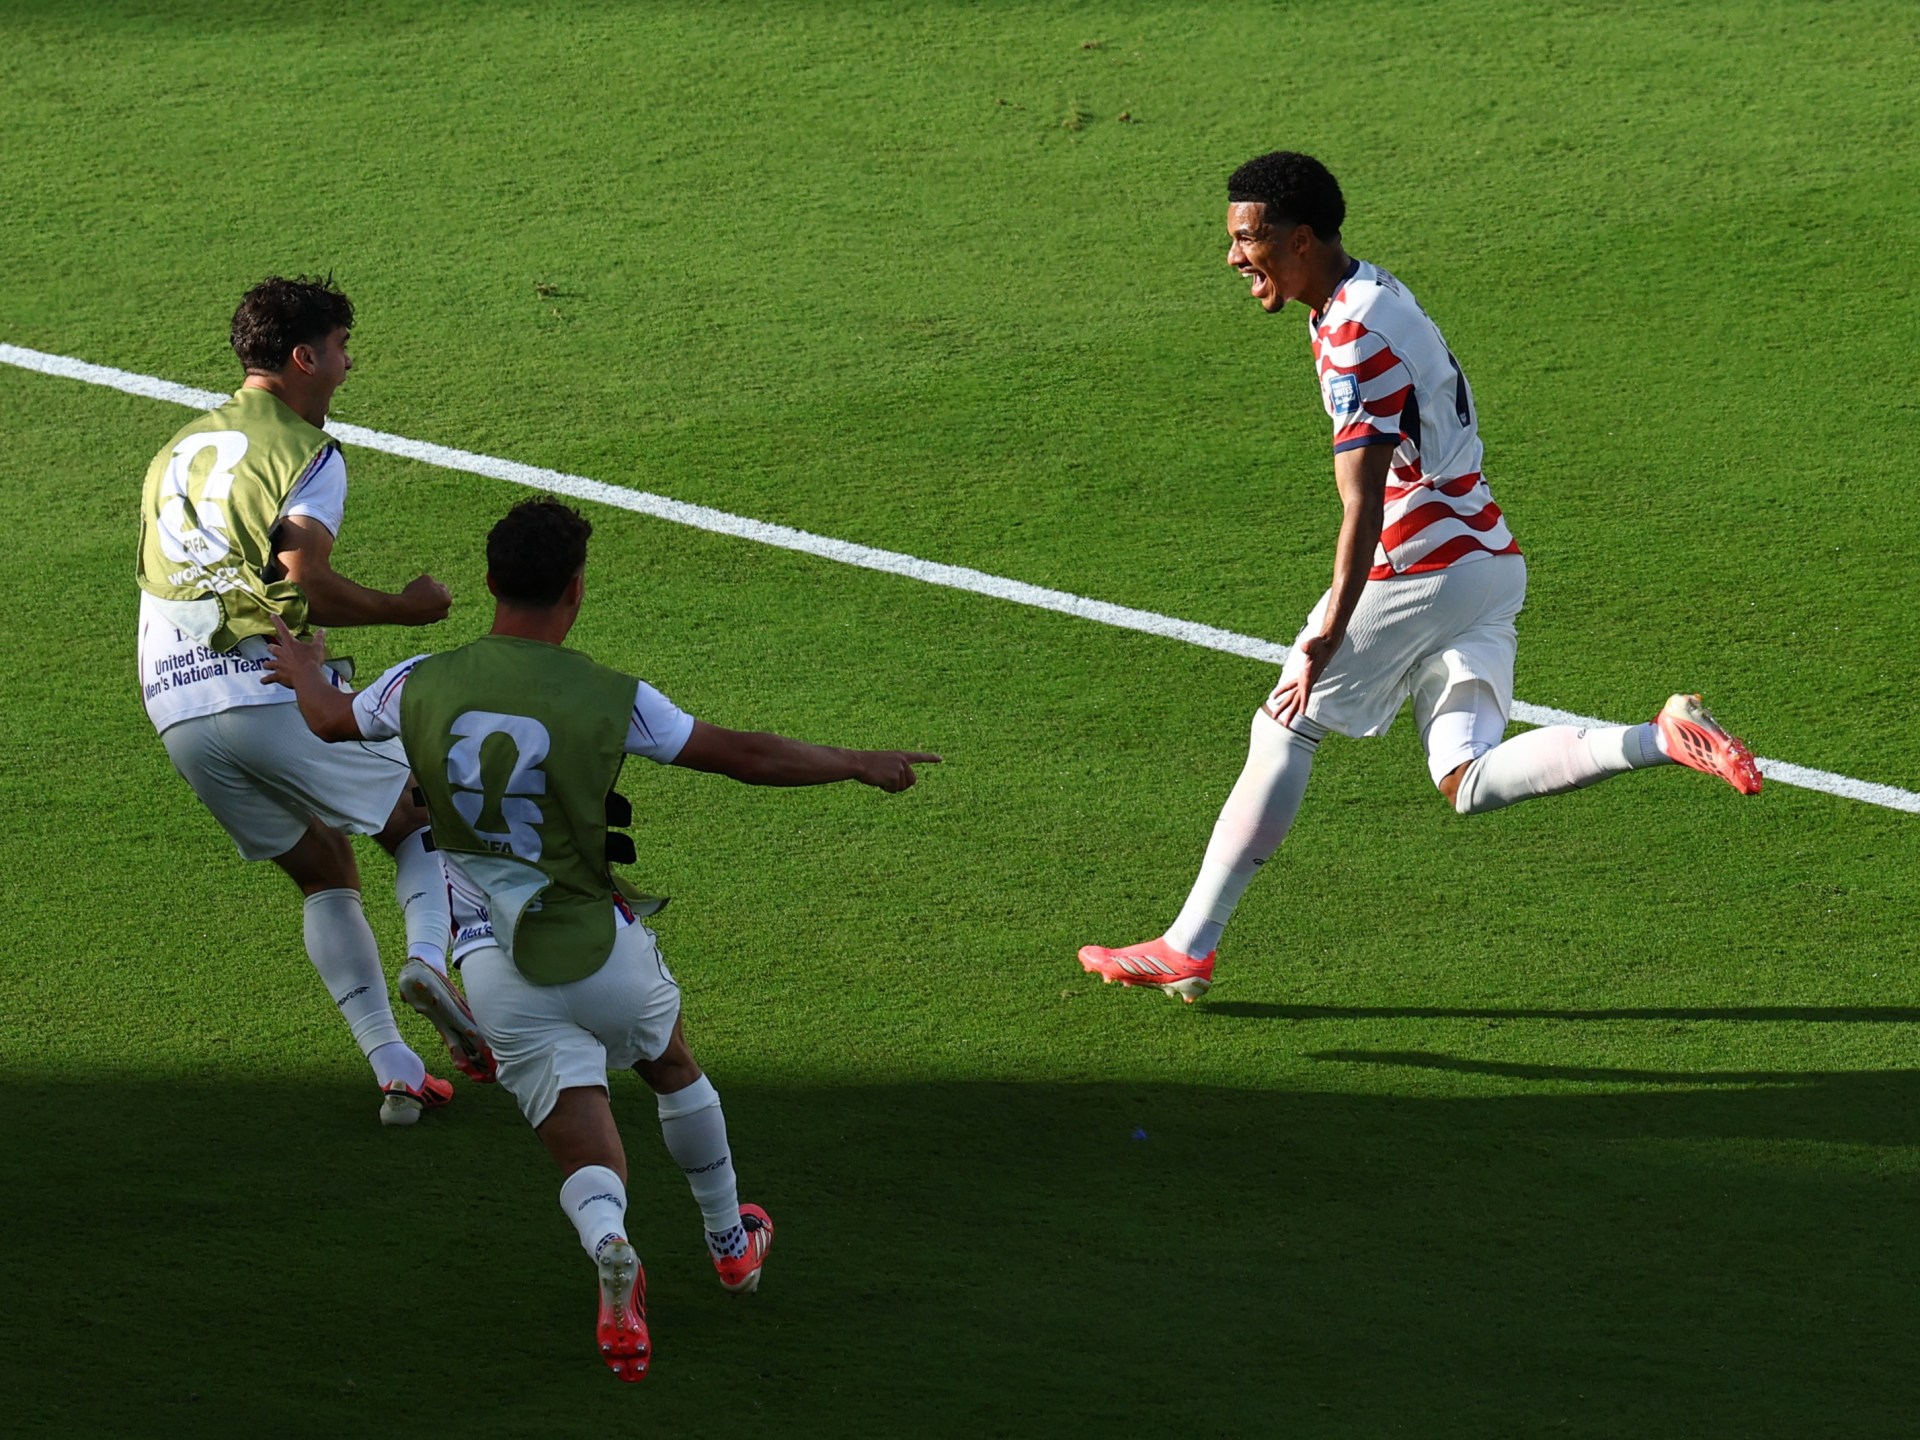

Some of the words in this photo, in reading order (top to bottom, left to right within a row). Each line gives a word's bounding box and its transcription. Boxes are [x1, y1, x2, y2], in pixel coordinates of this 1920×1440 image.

[167, 566, 210, 586] WORL
[155, 649, 195, 676] United
[144, 676, 170, 701] Men's
[172, 659, 229, 688] National
